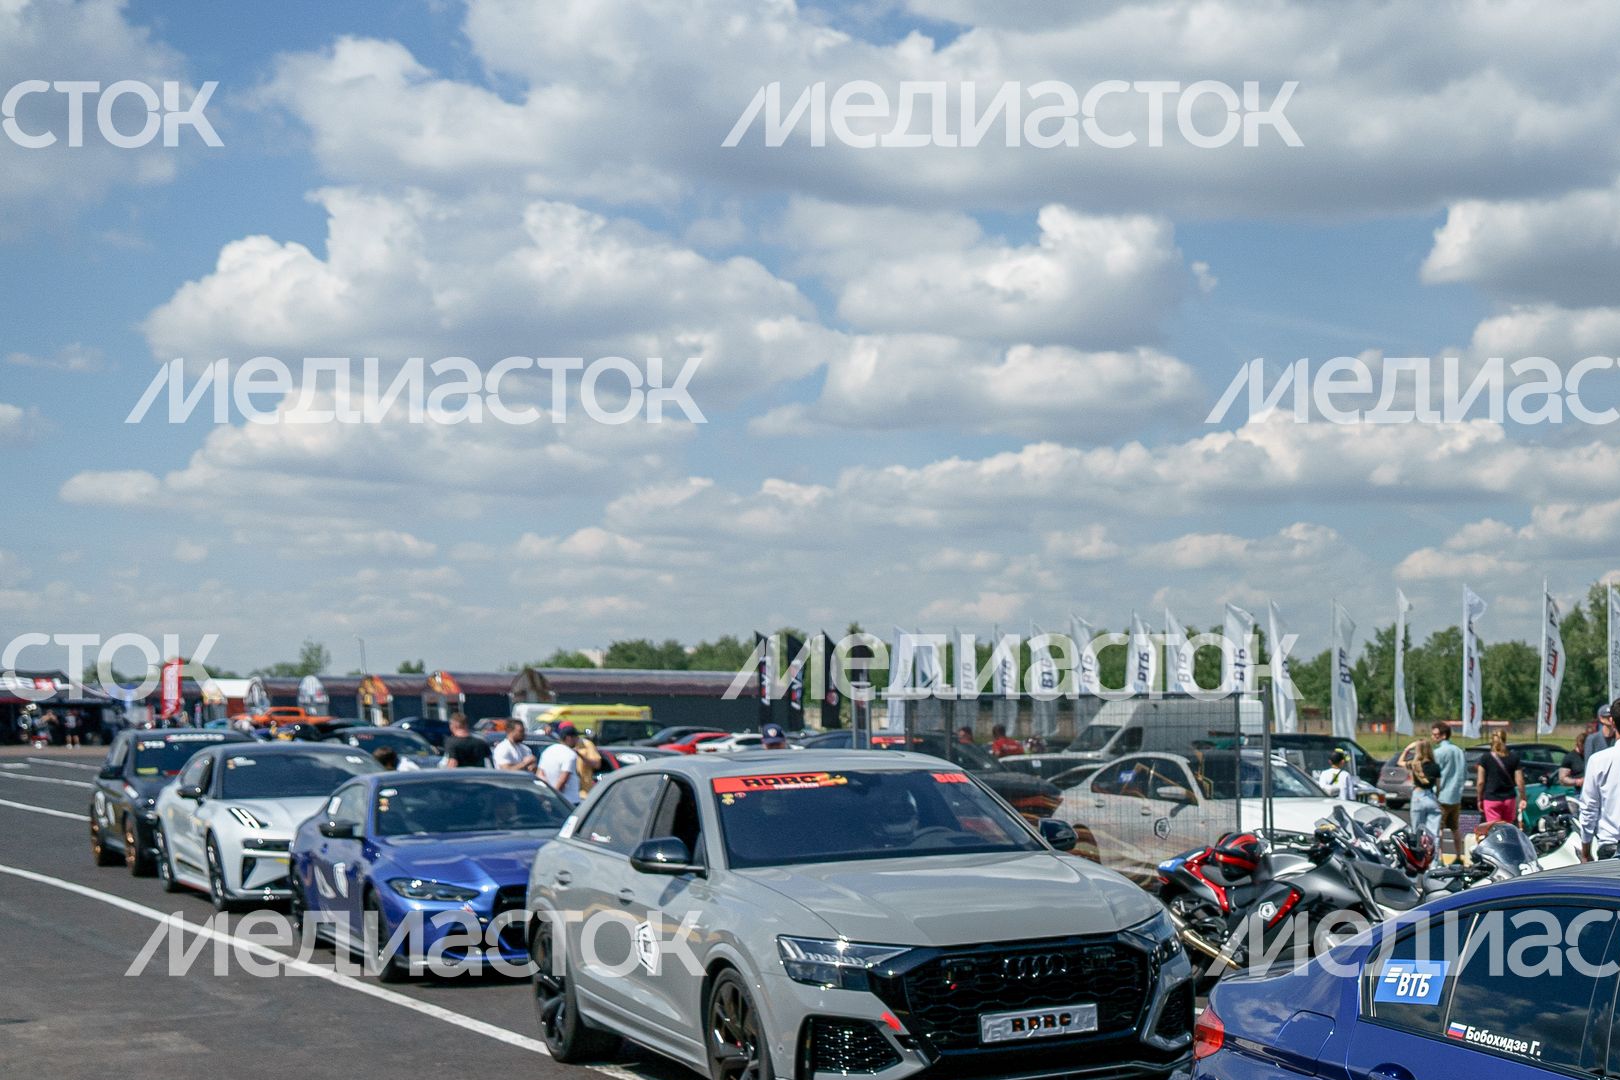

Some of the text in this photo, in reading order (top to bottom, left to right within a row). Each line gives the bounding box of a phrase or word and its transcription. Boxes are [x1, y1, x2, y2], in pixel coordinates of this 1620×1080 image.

[1396, 972, 1432, 998] ВТБ
[1011, 1012, 1072, 1033] RDRC
[1465, 1025, 1542, 1056] Бобохидзе Г.
